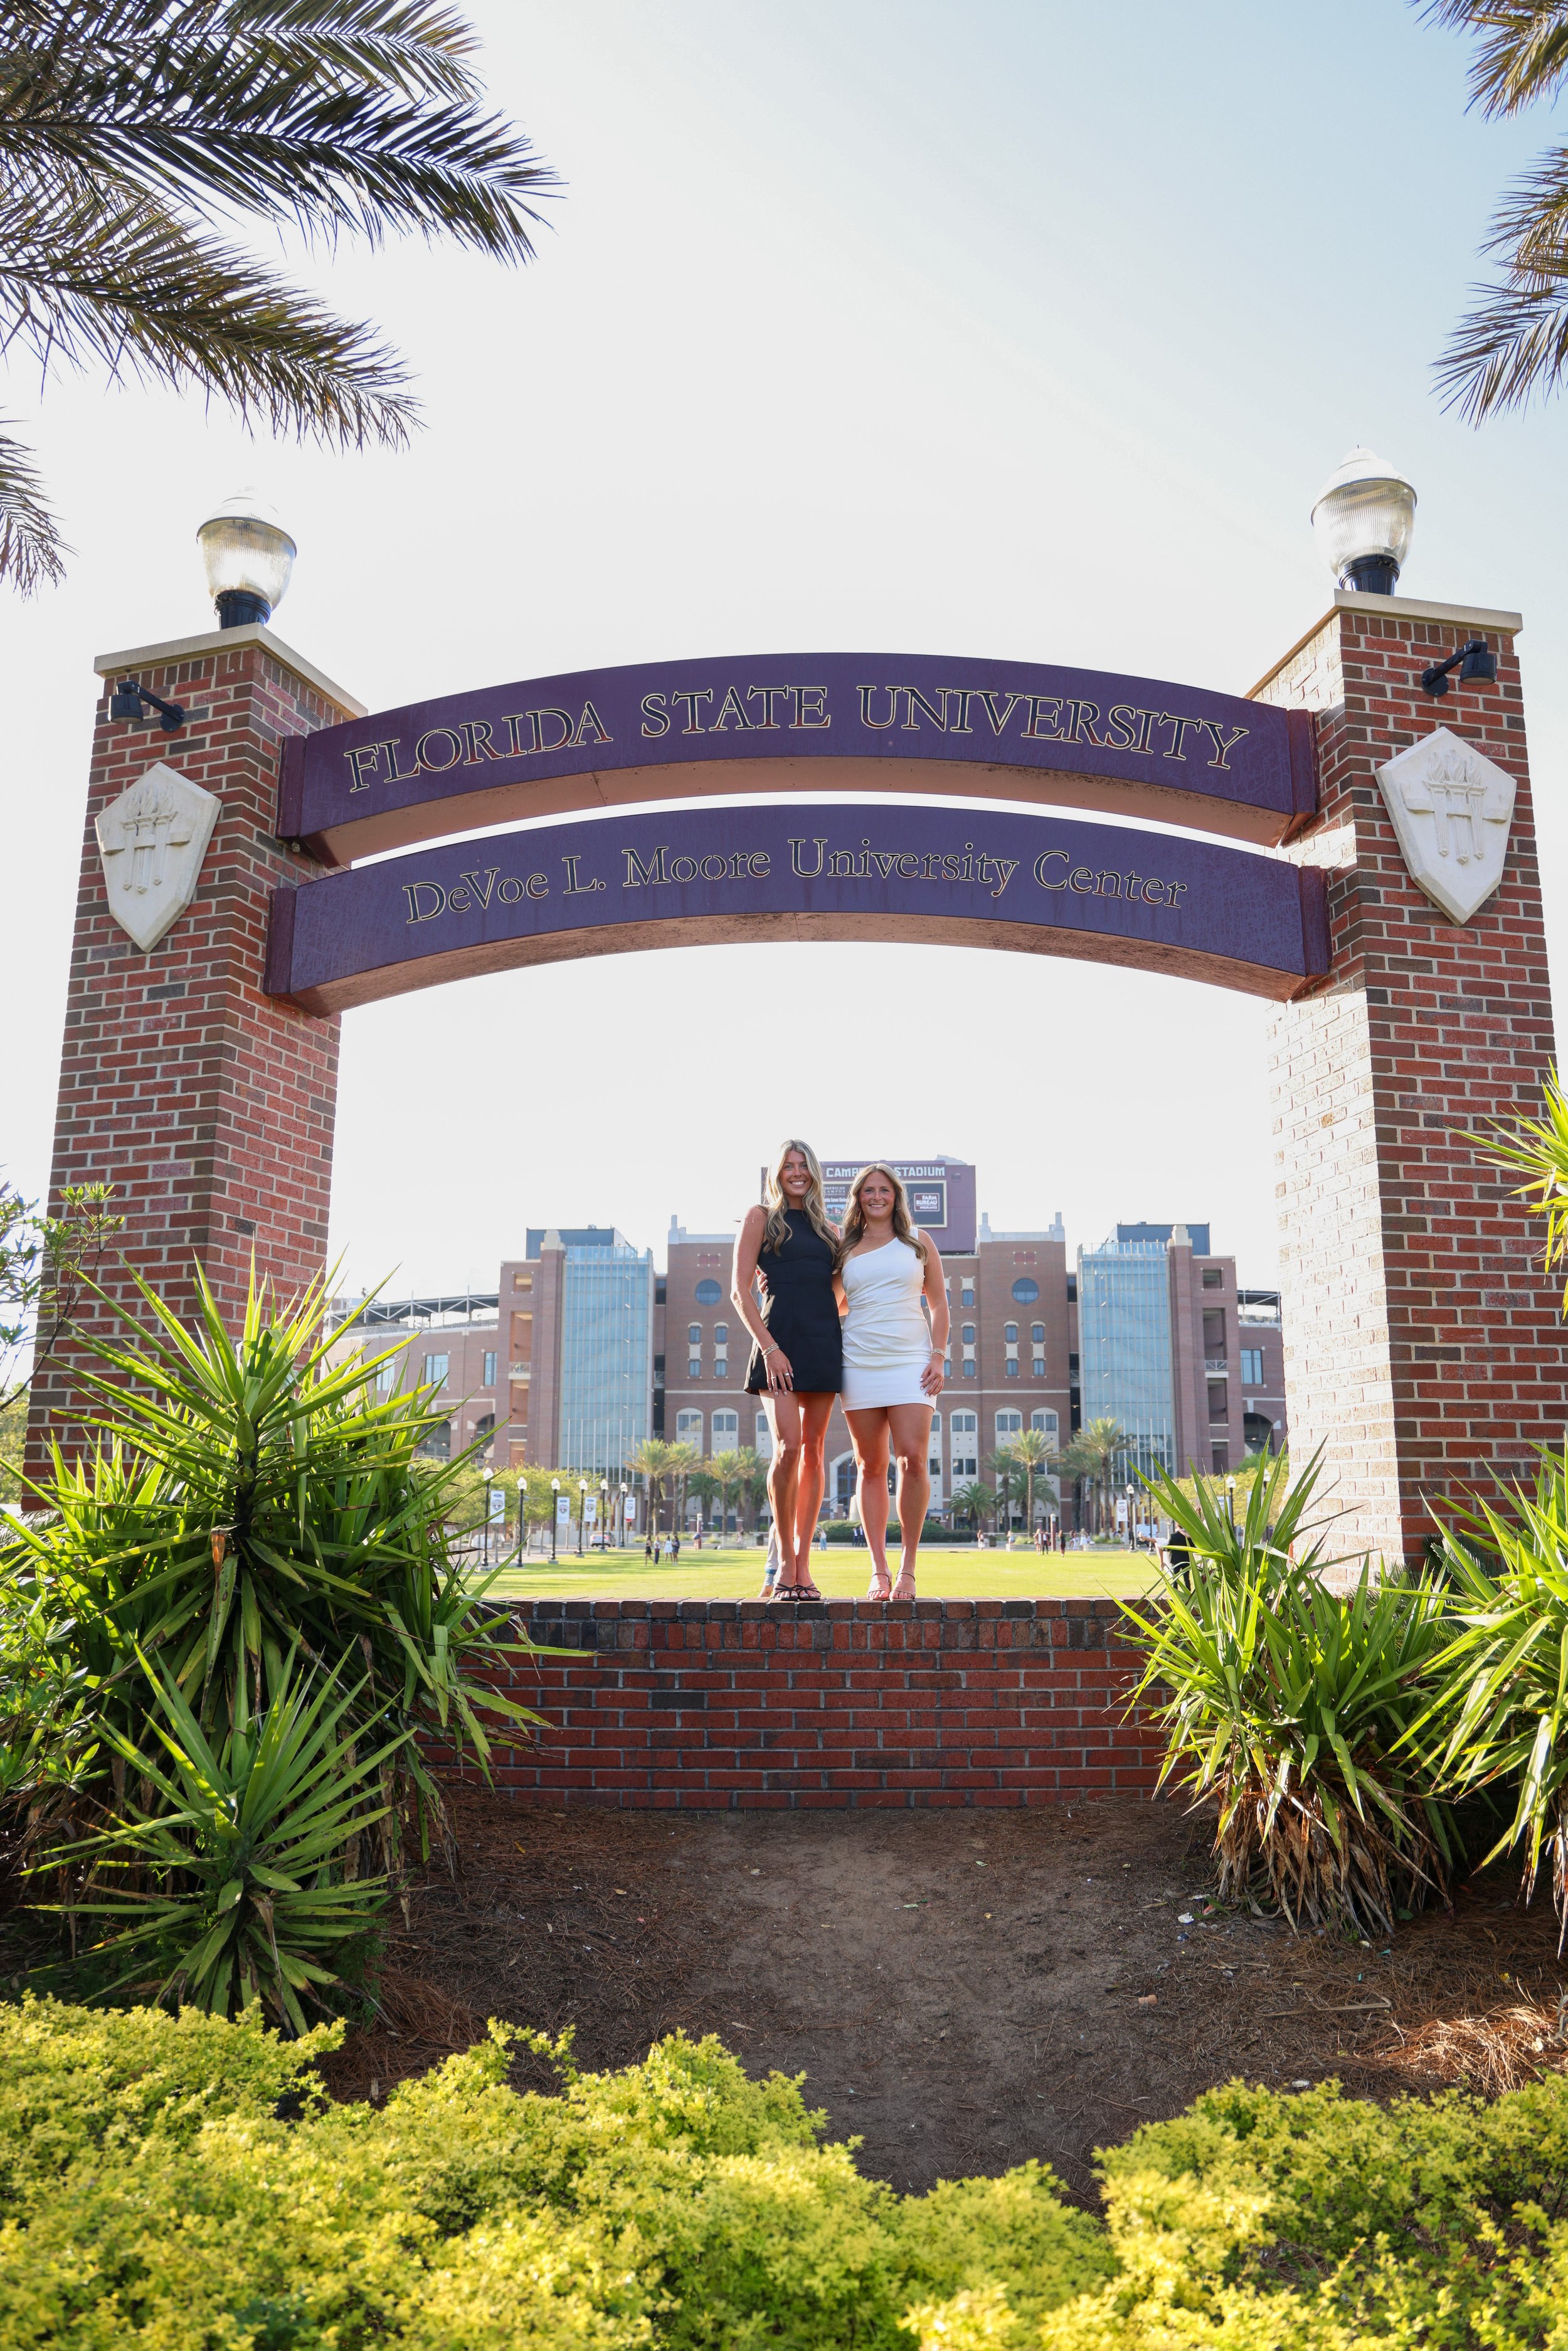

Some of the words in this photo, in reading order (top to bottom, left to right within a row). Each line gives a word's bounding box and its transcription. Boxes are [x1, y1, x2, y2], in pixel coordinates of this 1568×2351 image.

[344, 701, 613, 793] FLORIDA
[641, 685, 831, 738] STATE
[857, 686, 1249, 770] UNIVERSITY
[402, 867, 549, 925] DeVoe
[563, 855, 607, 894] L.
[622, 846, 771, 888] Moore
[788, 838, 1019, 898] University
[1033, 850, 1187, 909] Center
[893, 1166, 945, 1177] STADIUM
